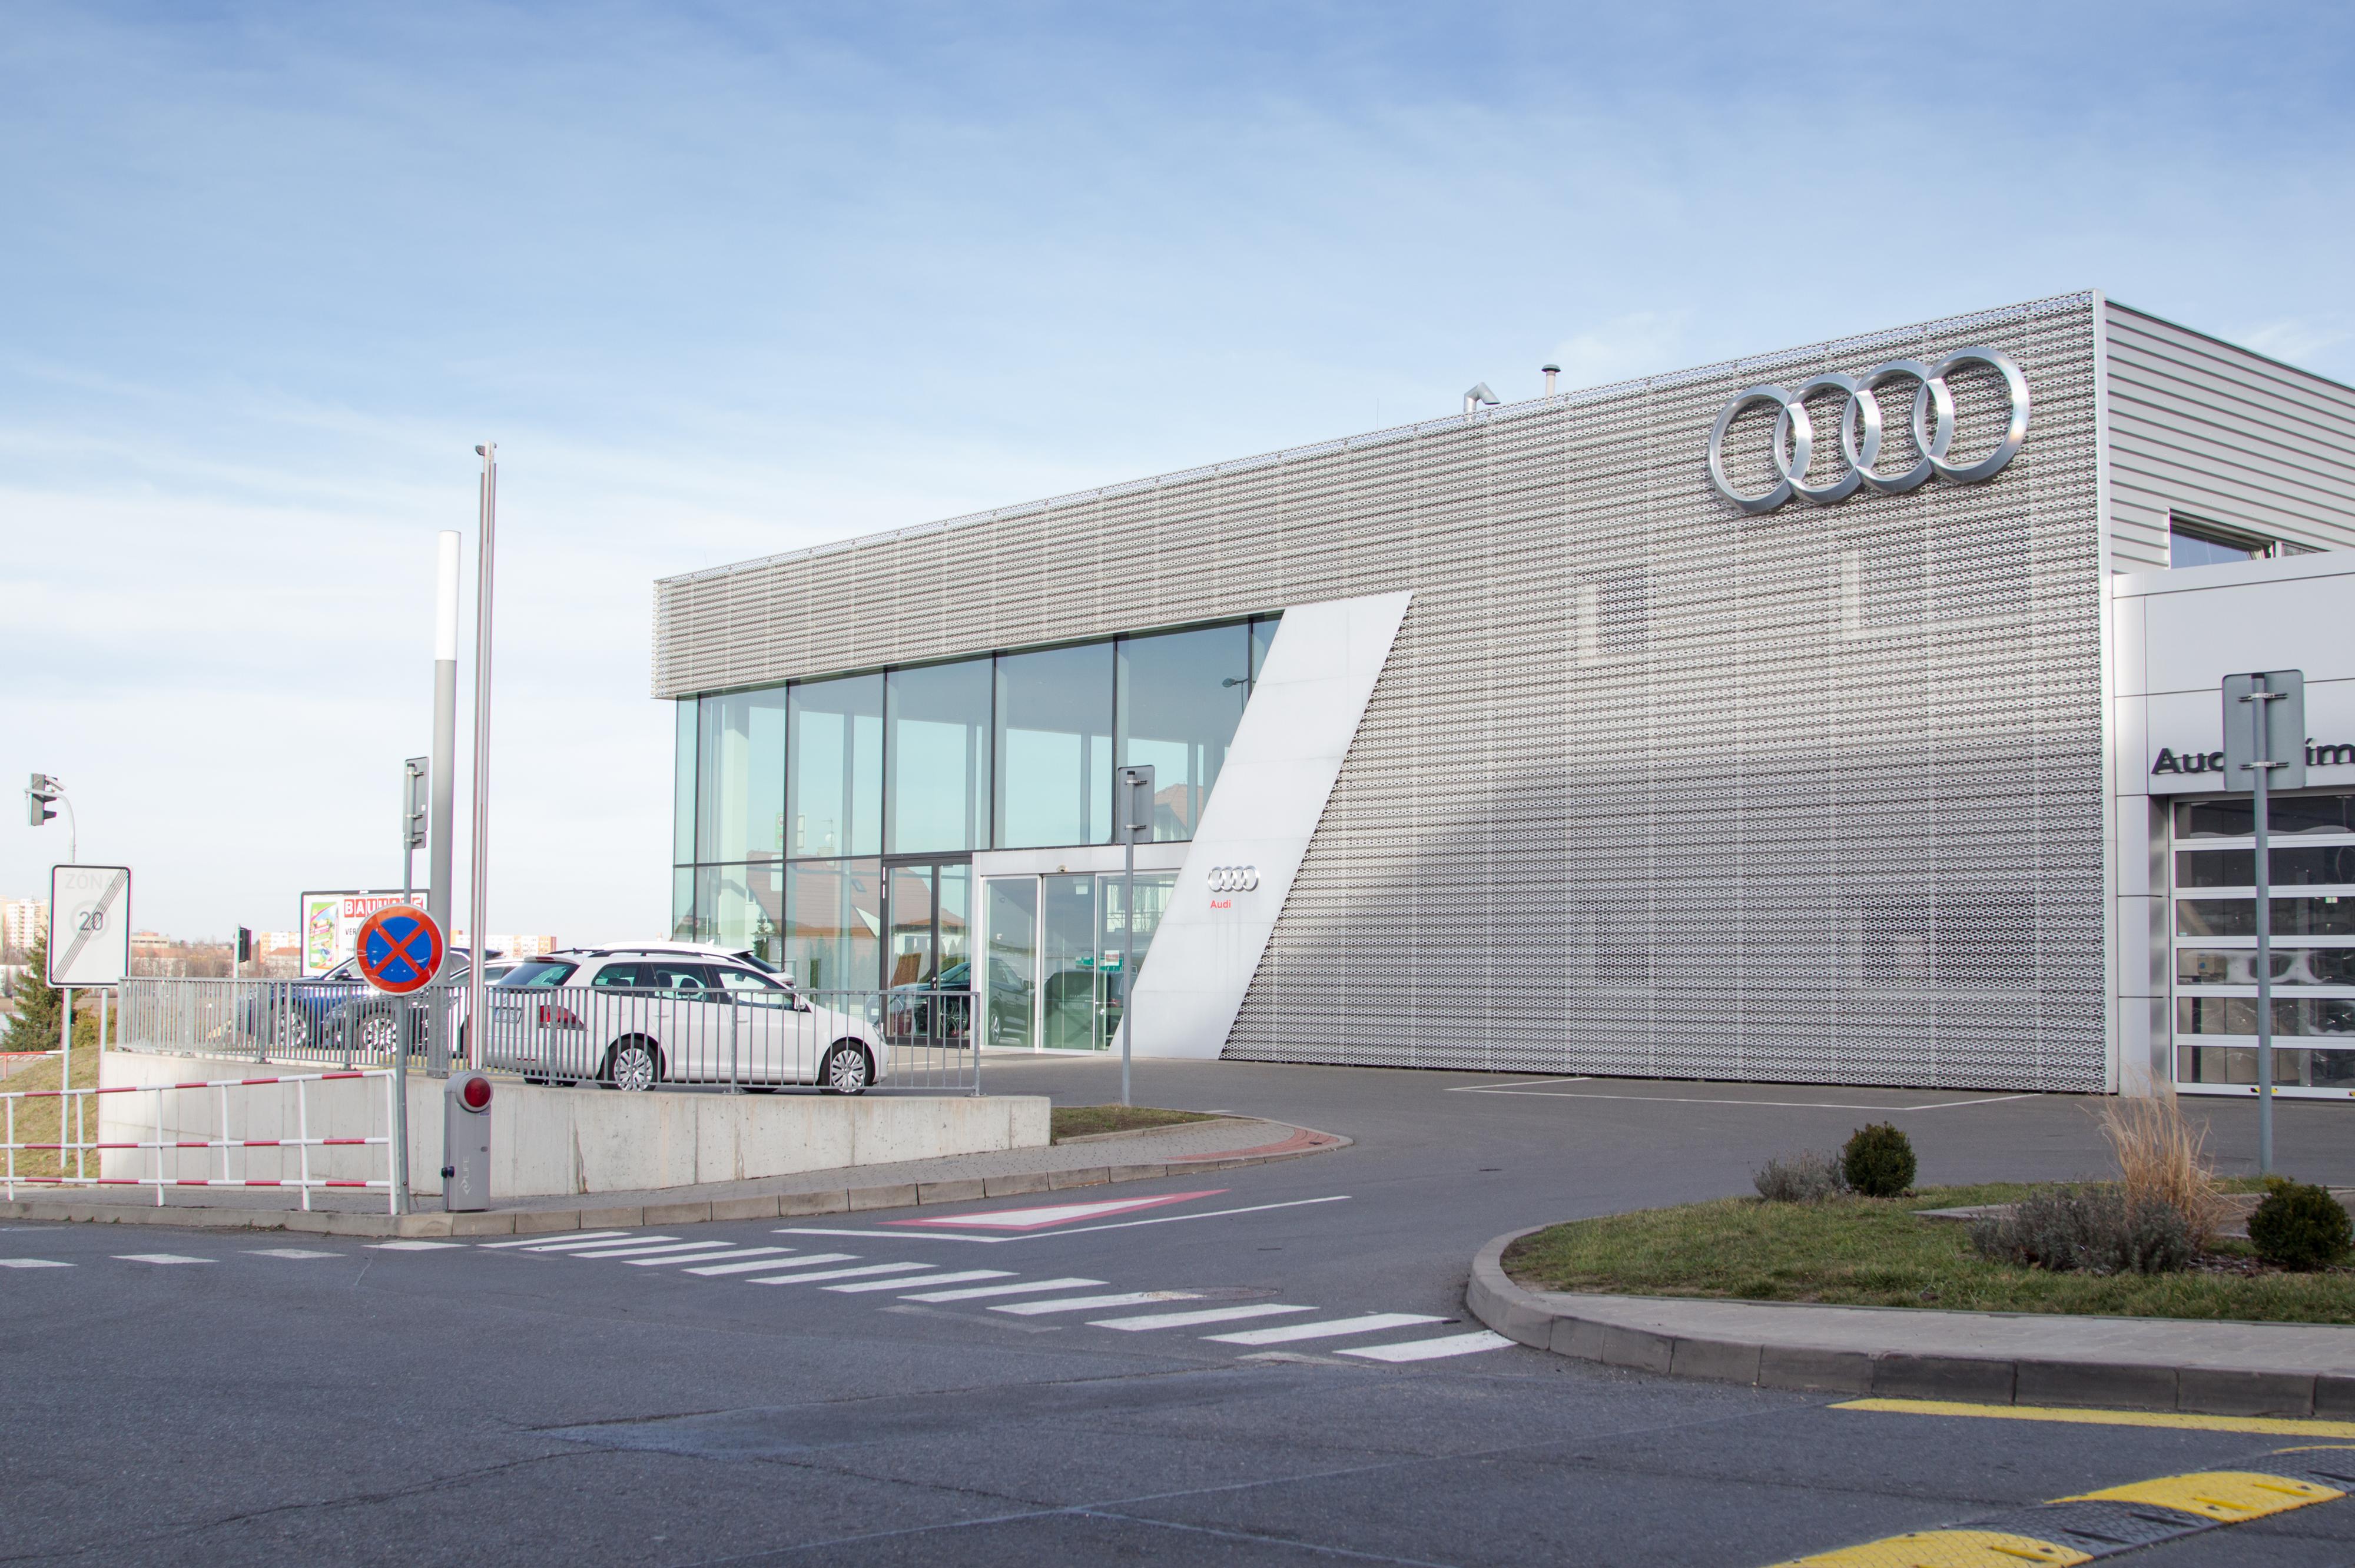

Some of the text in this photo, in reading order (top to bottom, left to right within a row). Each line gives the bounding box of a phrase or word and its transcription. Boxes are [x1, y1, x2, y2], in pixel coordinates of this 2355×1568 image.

[65, 869, 117, 889] ZÓNA
[344, 898, 424, 916] BAUHS
[1210, 899, 1231, 908] Audi
[79, 911, 104, 931] 20
